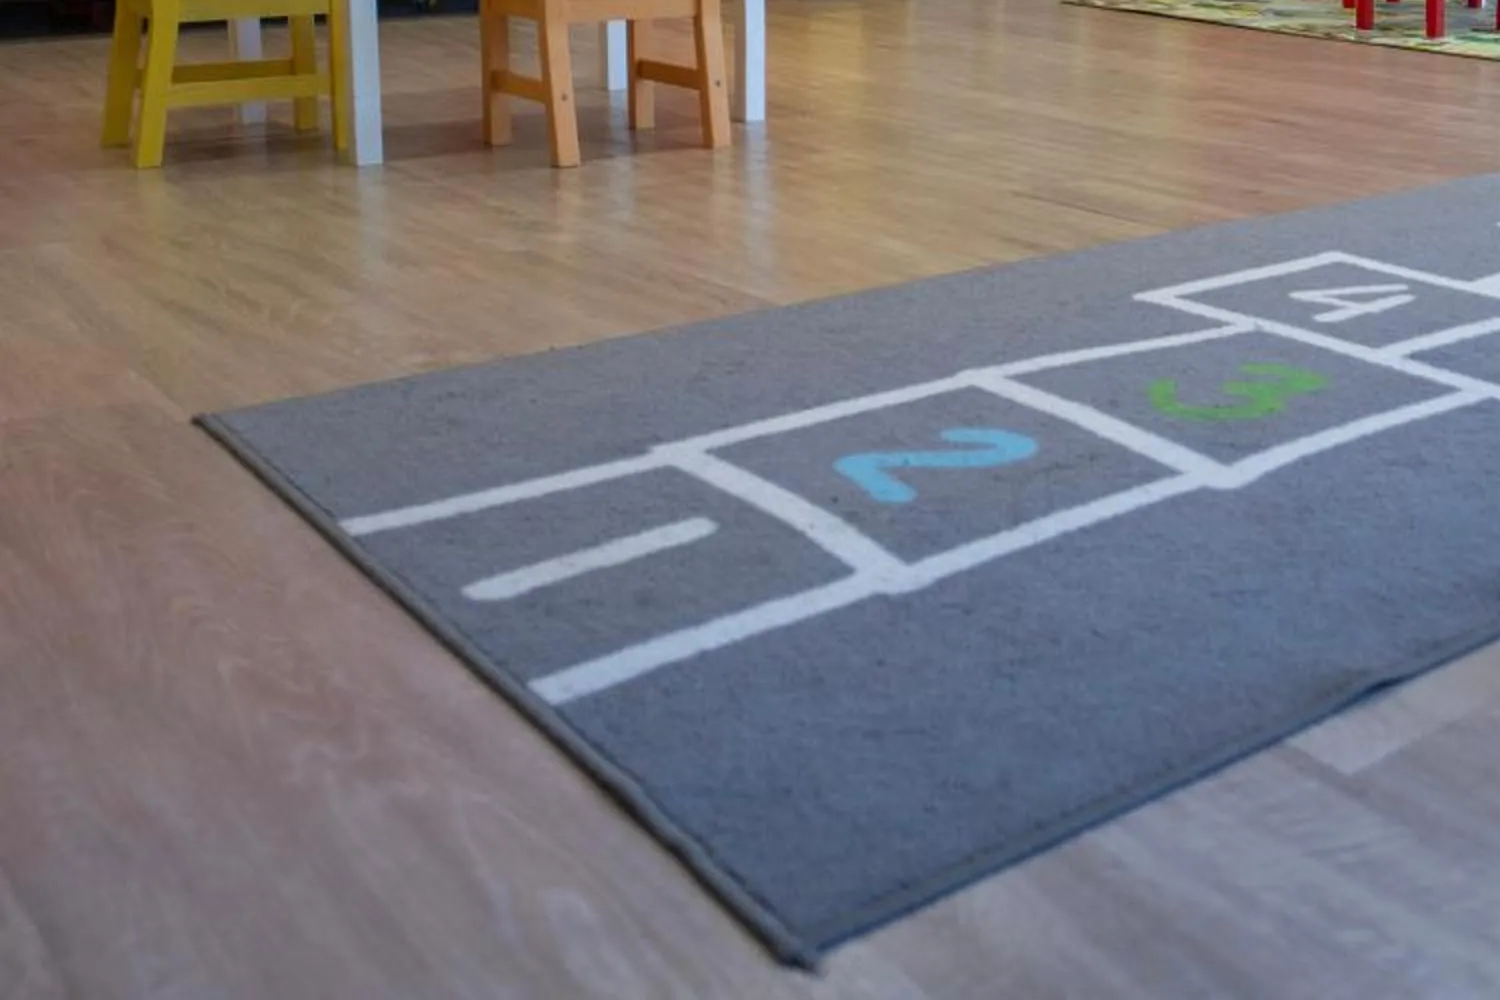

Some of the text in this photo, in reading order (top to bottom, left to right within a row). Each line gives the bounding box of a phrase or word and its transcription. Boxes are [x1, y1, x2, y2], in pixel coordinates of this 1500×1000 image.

[1288, 283, 1416, 323] 4
[1146, 361, 1330, 421] 3
[832, 427, 1039, 503] 2
[461, 516, 720, 600] 1
